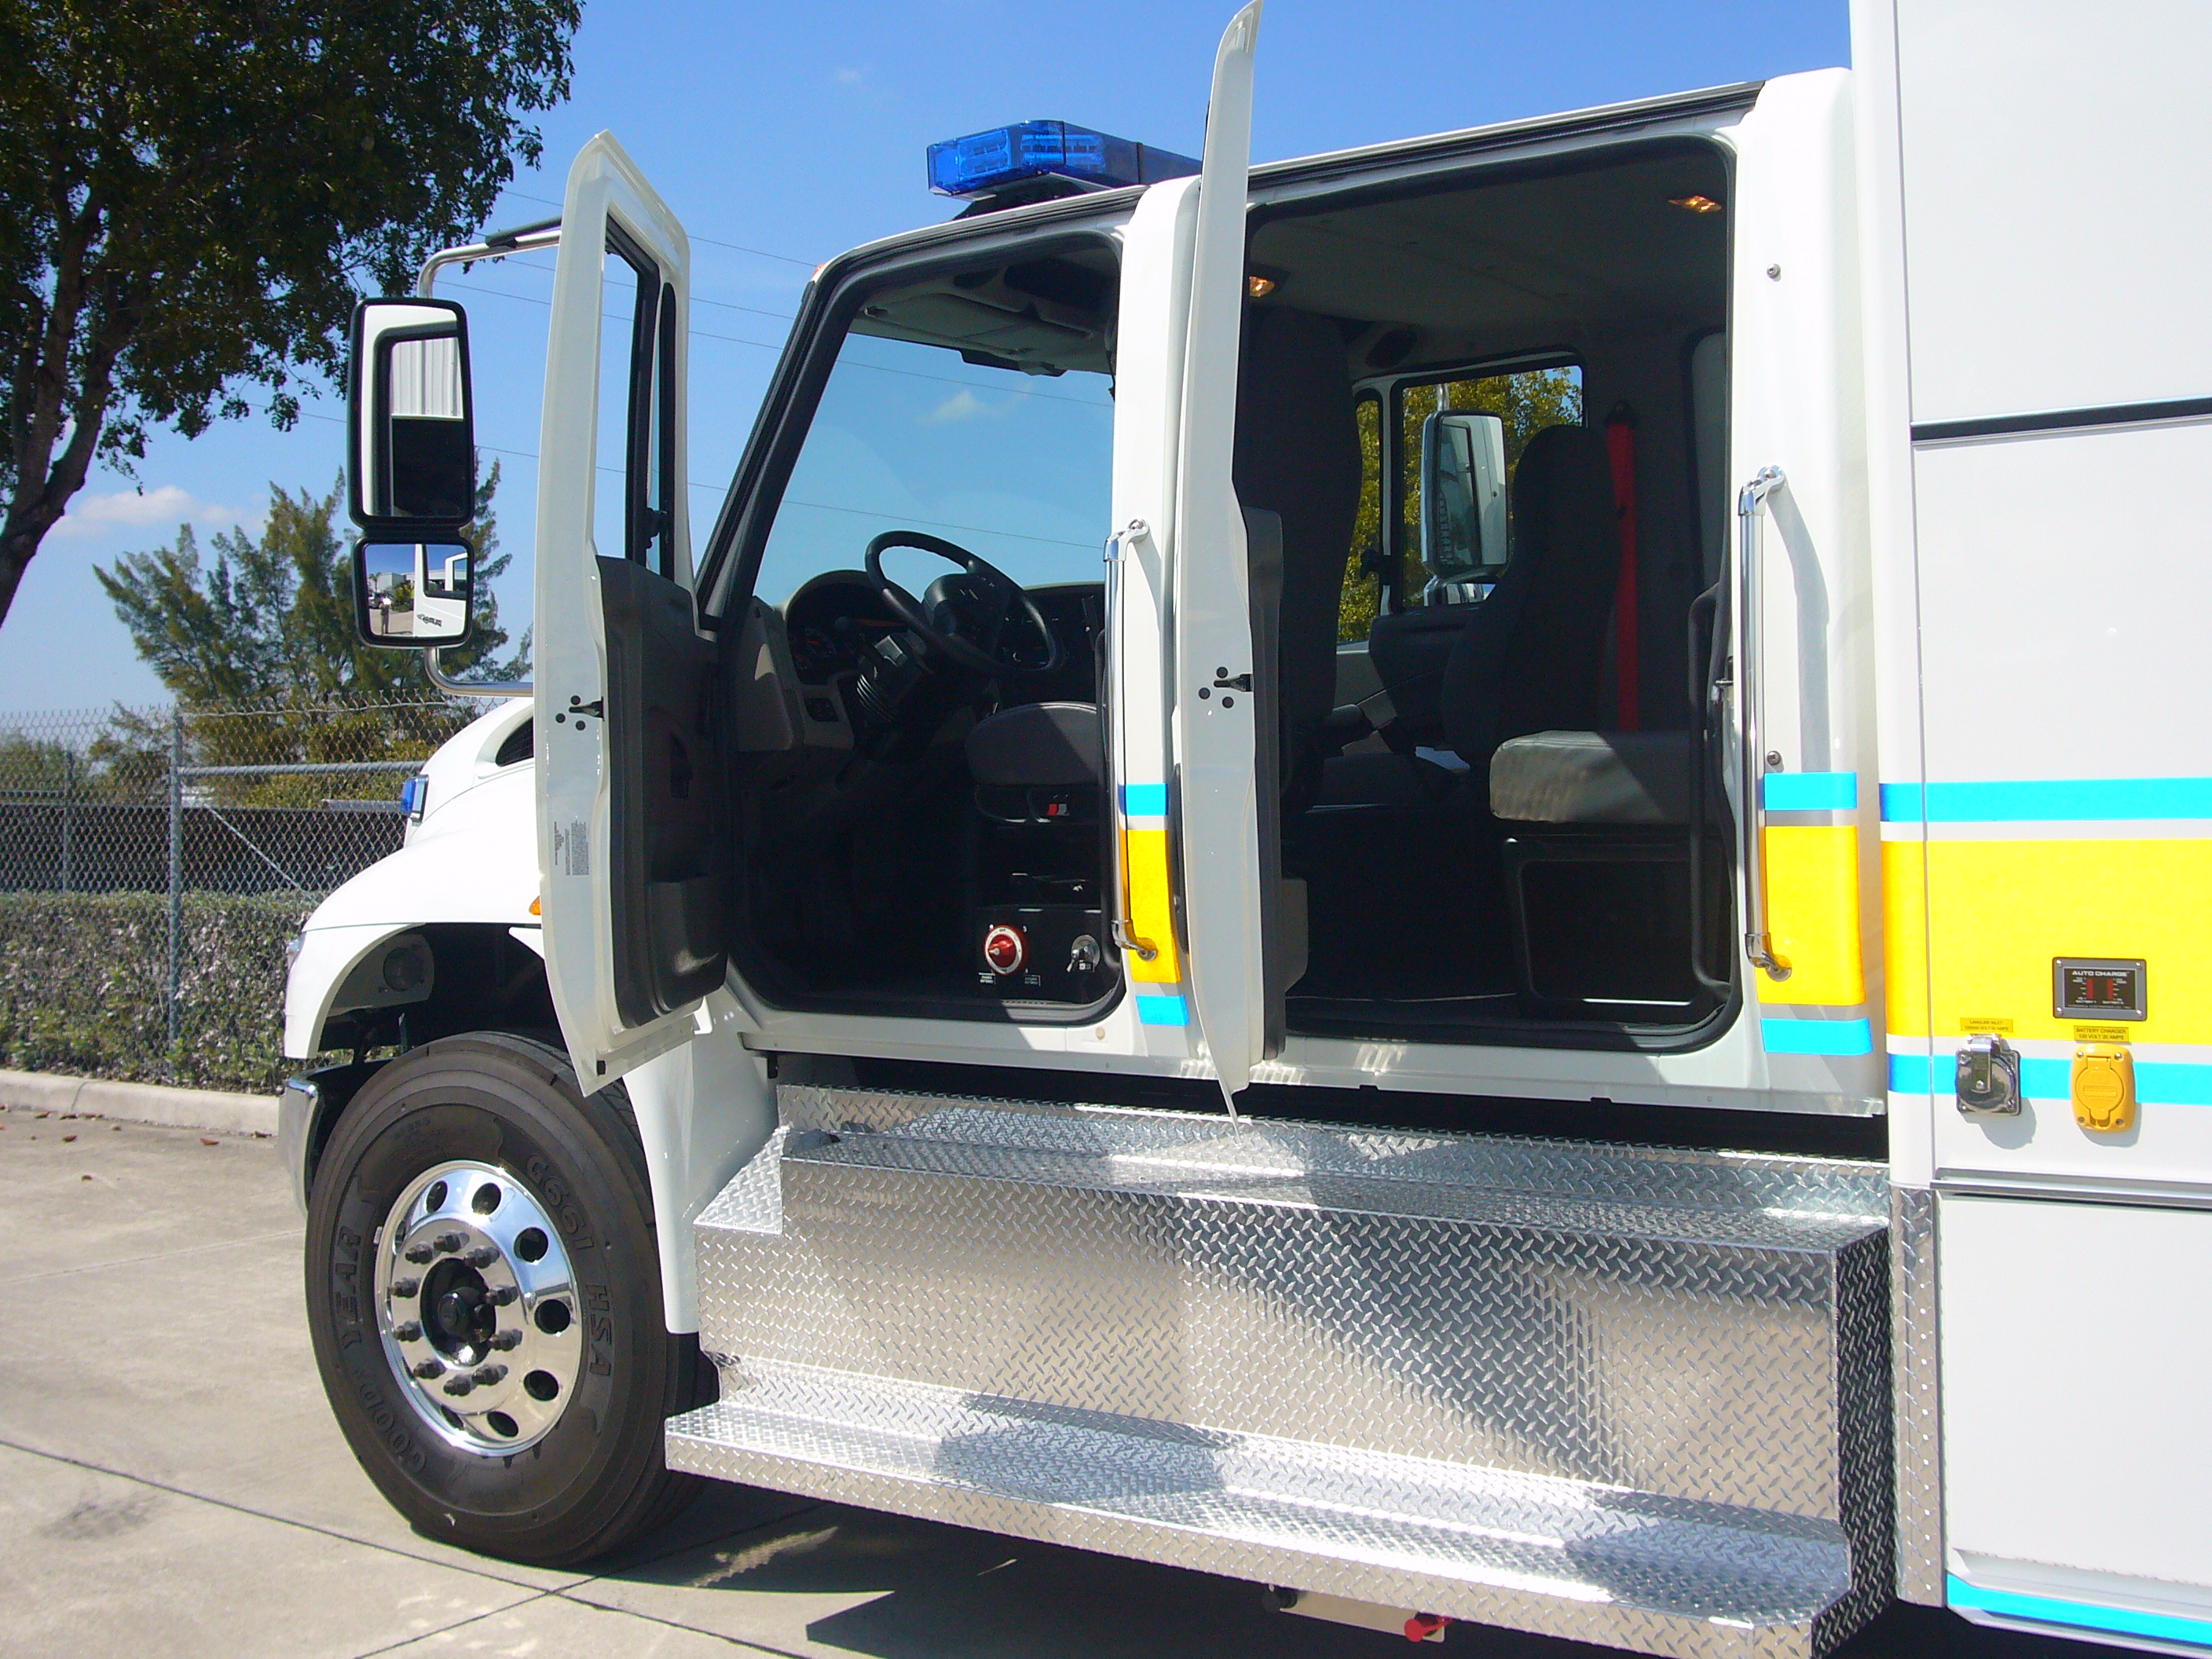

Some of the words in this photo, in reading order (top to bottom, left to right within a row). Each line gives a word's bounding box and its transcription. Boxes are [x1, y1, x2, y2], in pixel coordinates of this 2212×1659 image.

[333, 1225, 363, 1350] YEAR
[526, 1154, 595, 1251] G661
[586, 1283, 613, 1377] HSA
